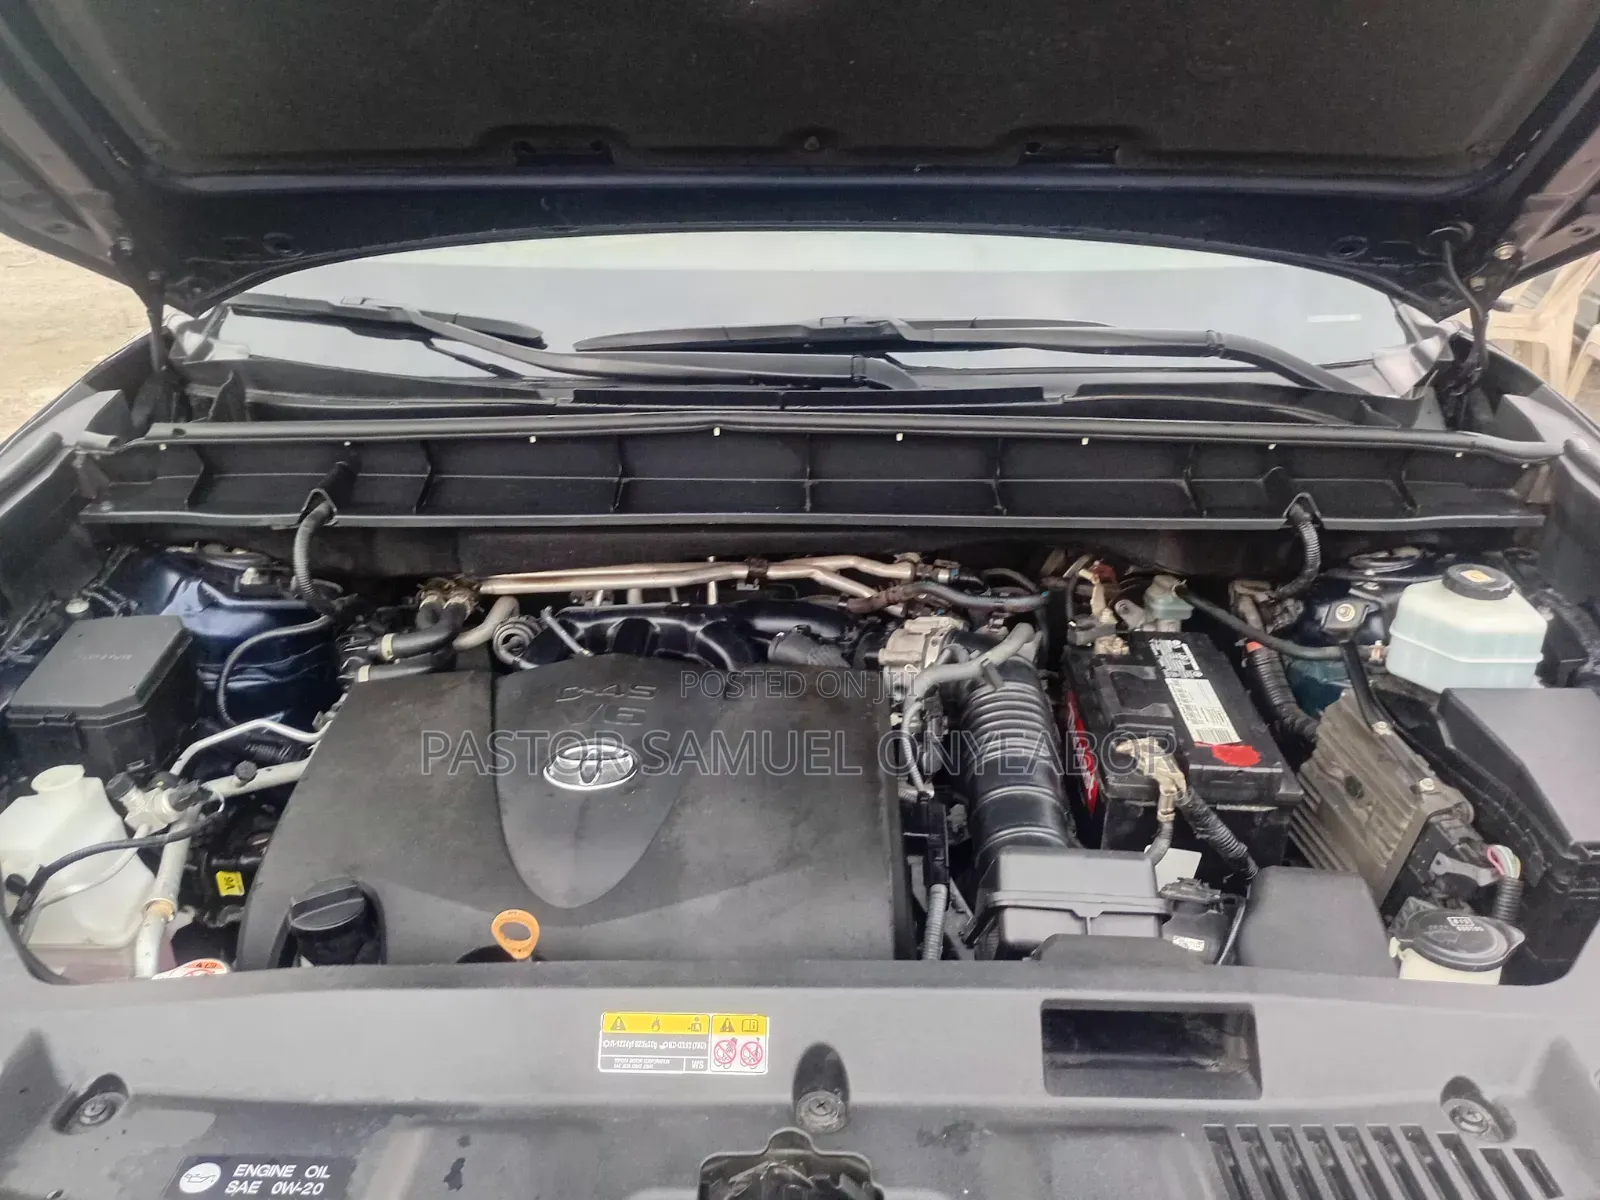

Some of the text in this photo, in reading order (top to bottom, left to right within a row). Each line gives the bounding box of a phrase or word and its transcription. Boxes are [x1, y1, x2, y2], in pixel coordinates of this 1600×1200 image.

[232, 1163, 332, 1179] ENGINE OIL
[224, 1179, 325, 1196] SAE 0W-20
